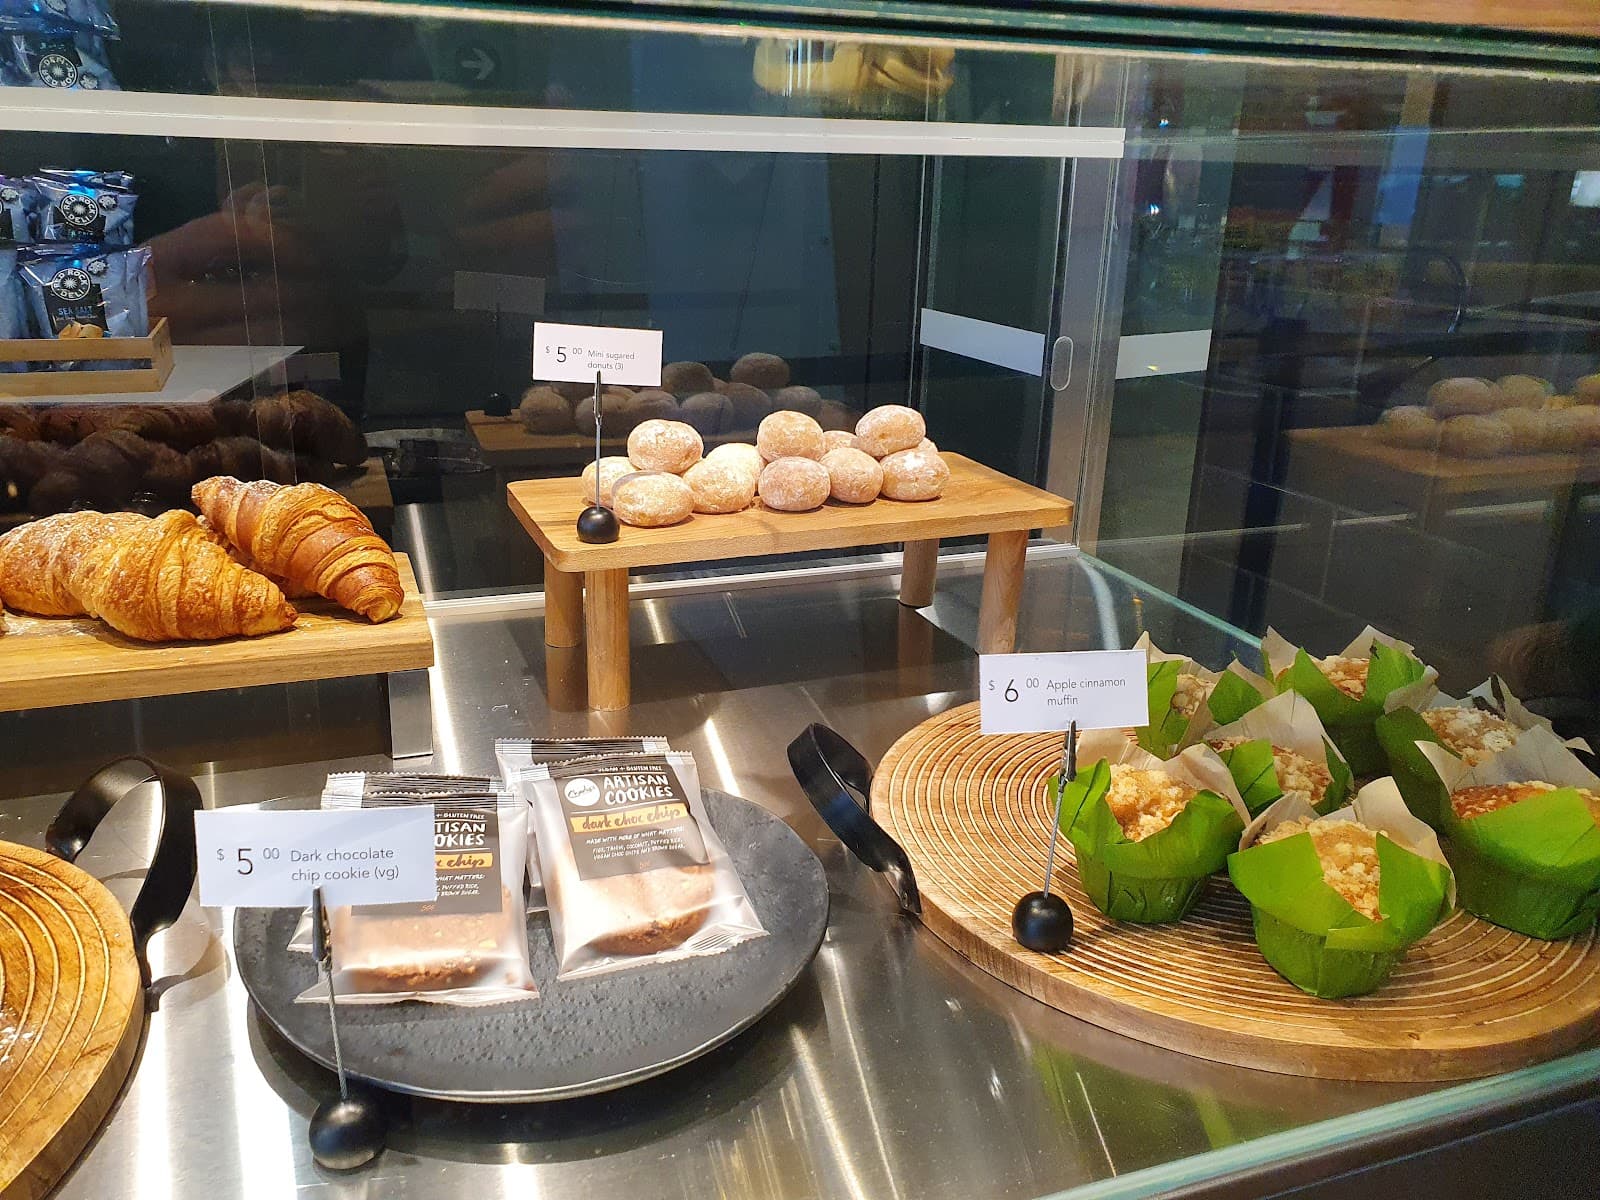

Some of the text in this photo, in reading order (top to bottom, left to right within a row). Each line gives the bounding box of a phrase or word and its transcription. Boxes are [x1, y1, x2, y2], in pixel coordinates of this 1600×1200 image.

[63, 196, 77, 210] RED
[79, 196, 96, 214] ROCK
[69, 214, 91, 223] DELI
[54, 269, 89, 288] RED ROCK
[60, 288, 85, 299] DELI
[545, 345, 550, 354] $
[556, 346, 567, 362] 5
[588, 350, 604, 358] Mini
[606, 352, 635, 360] sugared
[587, 362, 624, 370] donuts (3)
[988, 678, 1126, 702] $ 6 00 Apple cinnamon
[1047, 695, 1078, 706] muffin
[603, 774, 668, 790] ARTISAN
[604, 786, 674, 806] COOKIES
[582, 806, 680, 830] dark choc chip
[434, 822, 486, 833] TISAN
[434, 833, 485, 848] OKIES
[216, 848, 394, 876] $ 5 00 Dark chocolate
[446, 854, 484, 868] chip
[291, 865, 400, 884] chip cookie (vg)
